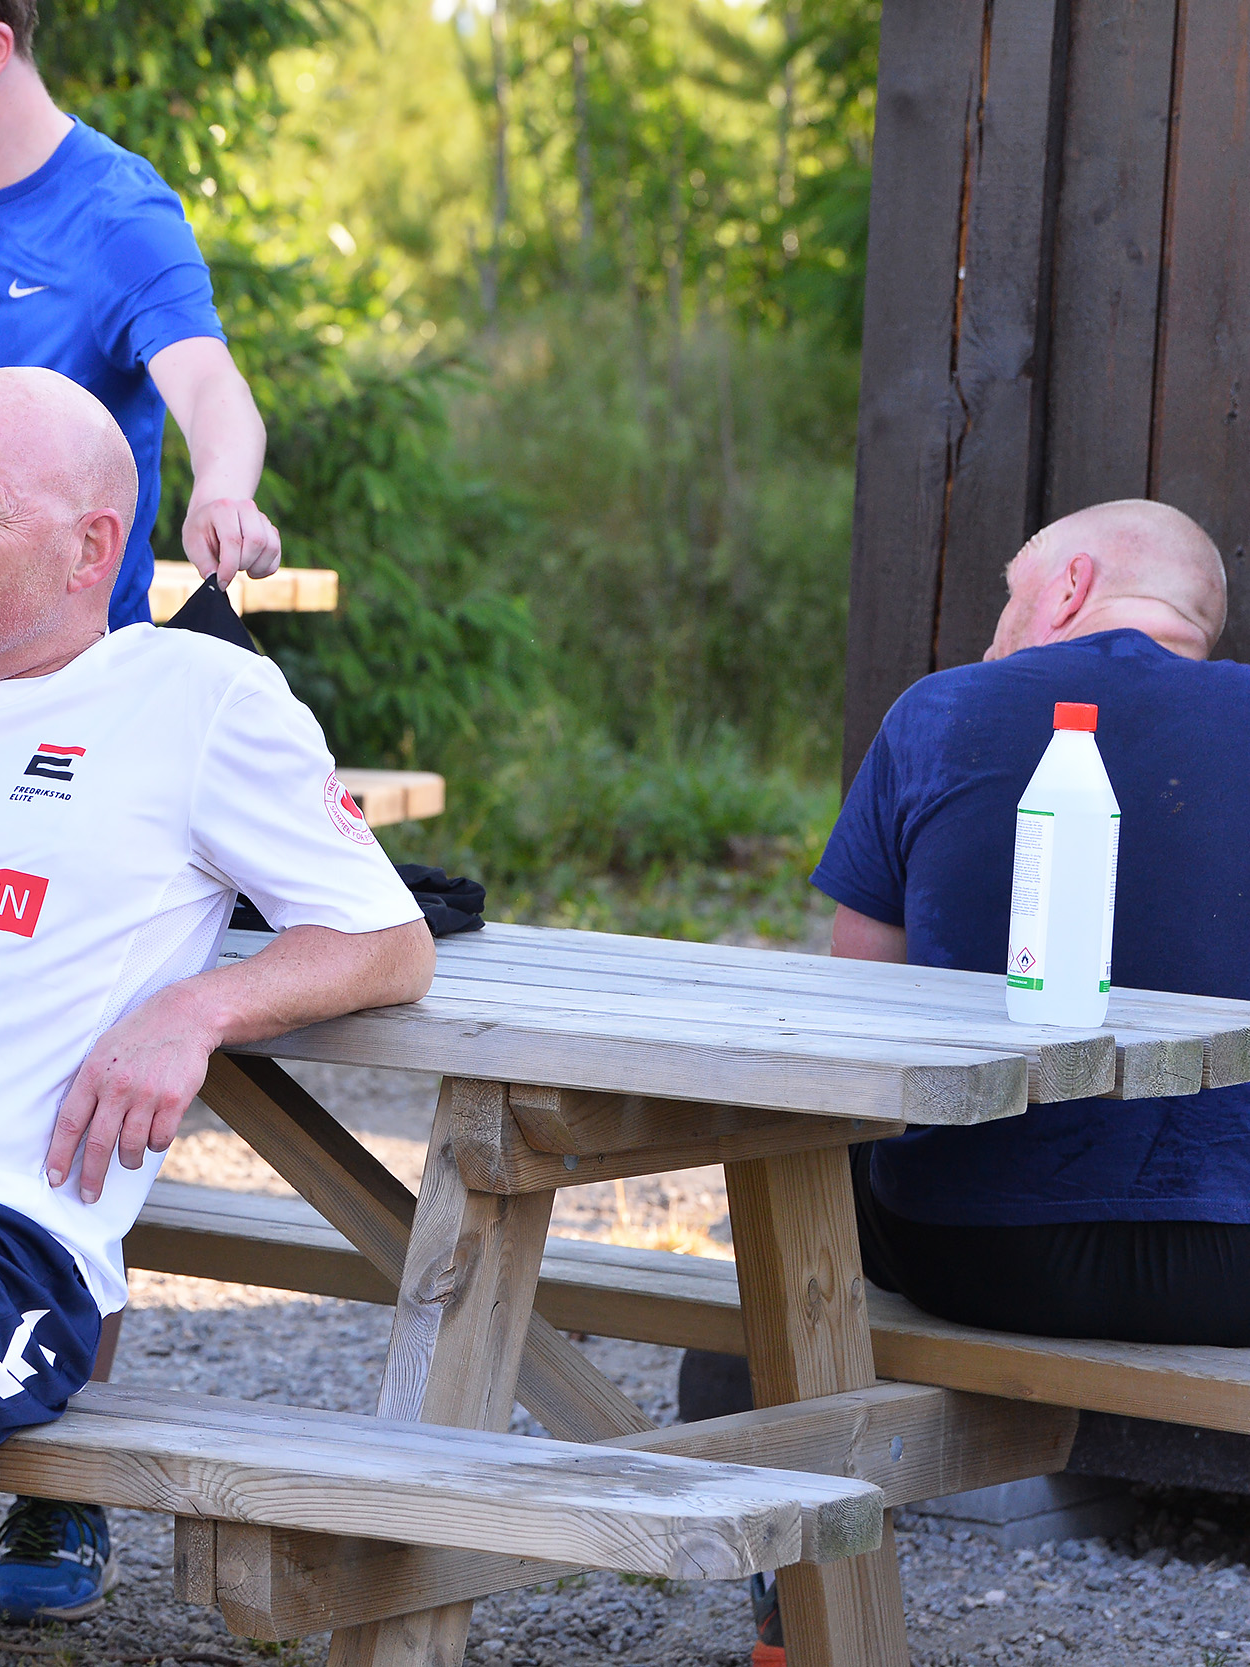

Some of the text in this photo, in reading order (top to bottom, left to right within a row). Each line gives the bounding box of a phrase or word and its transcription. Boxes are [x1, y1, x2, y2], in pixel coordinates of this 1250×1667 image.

[9, 793, 34, 803] ELITE
[13, 785, 72, 801] FREDRIKSTAD
[330, 805, 351, 835] SAMMEN
